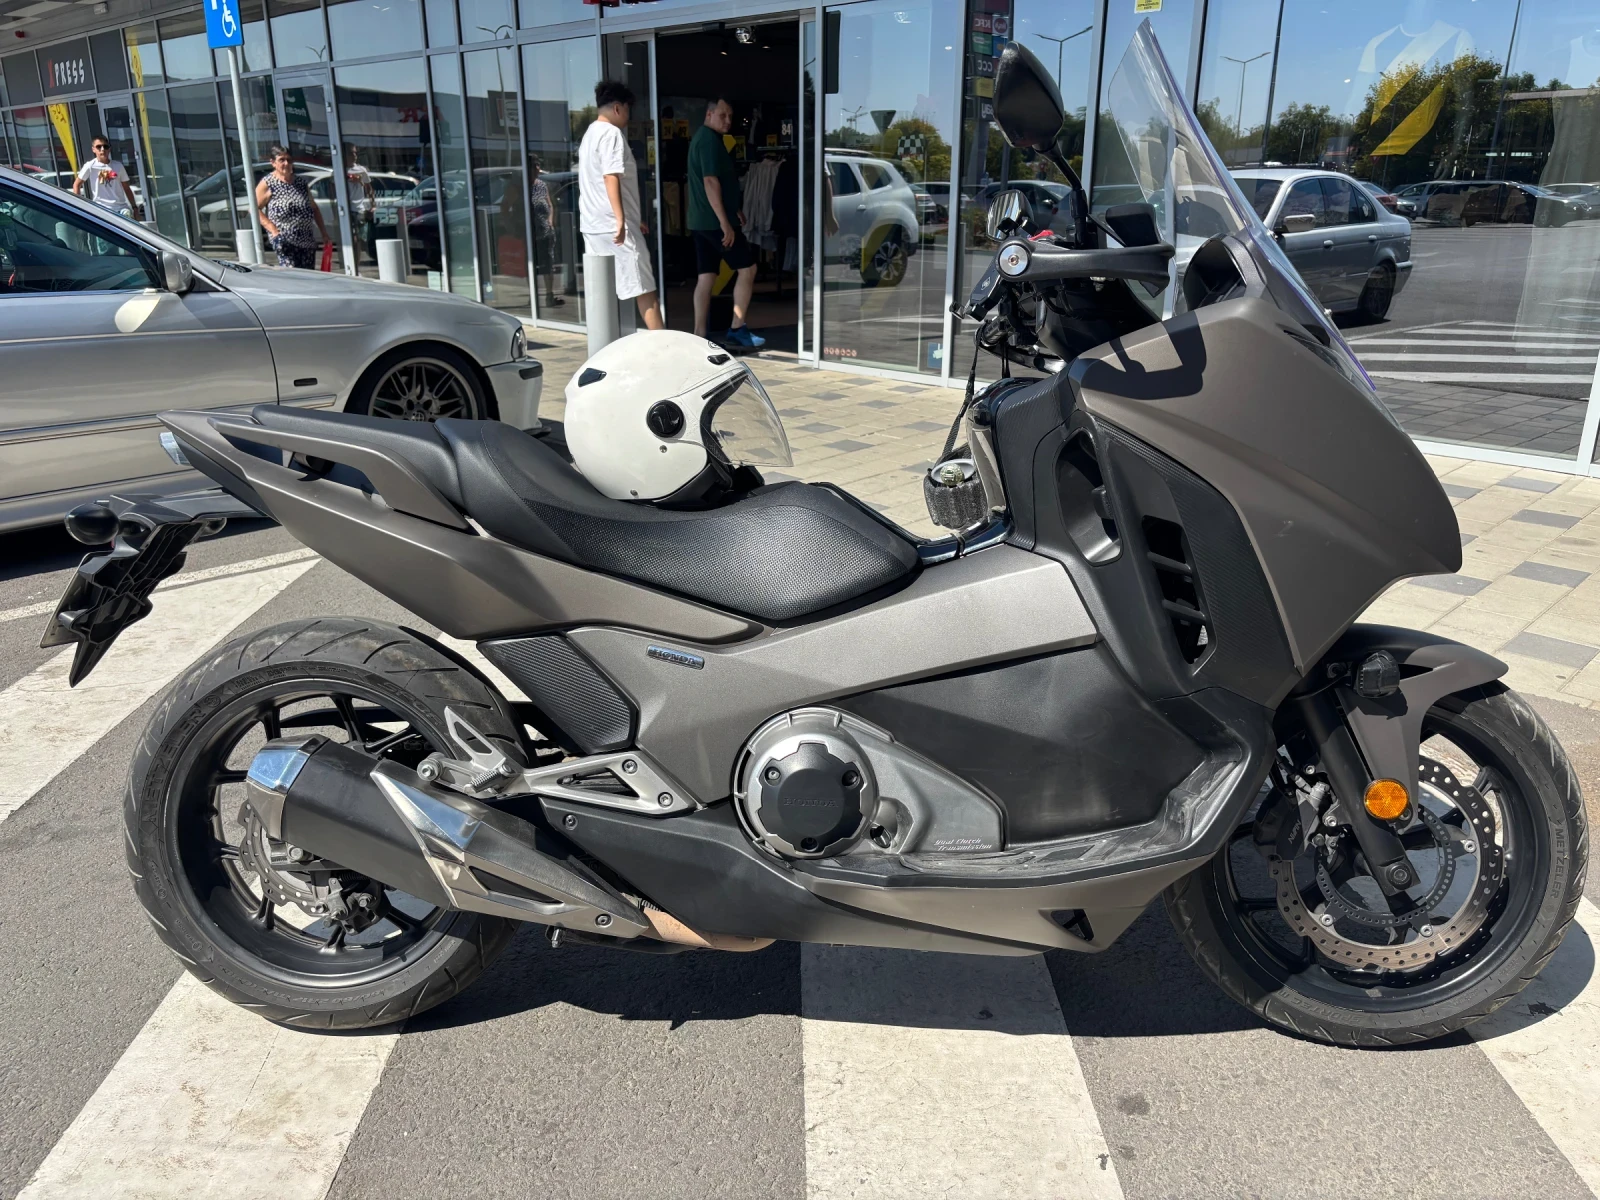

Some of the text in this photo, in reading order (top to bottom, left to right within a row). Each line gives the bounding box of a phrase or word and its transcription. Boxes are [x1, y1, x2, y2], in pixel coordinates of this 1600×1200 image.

[781, 123, 792, 136] 84
[142, 703, 207, 823] METZELER
[783, 797, 839, 808] HONDA
[1549, 827, 1566, 899] METZELER
